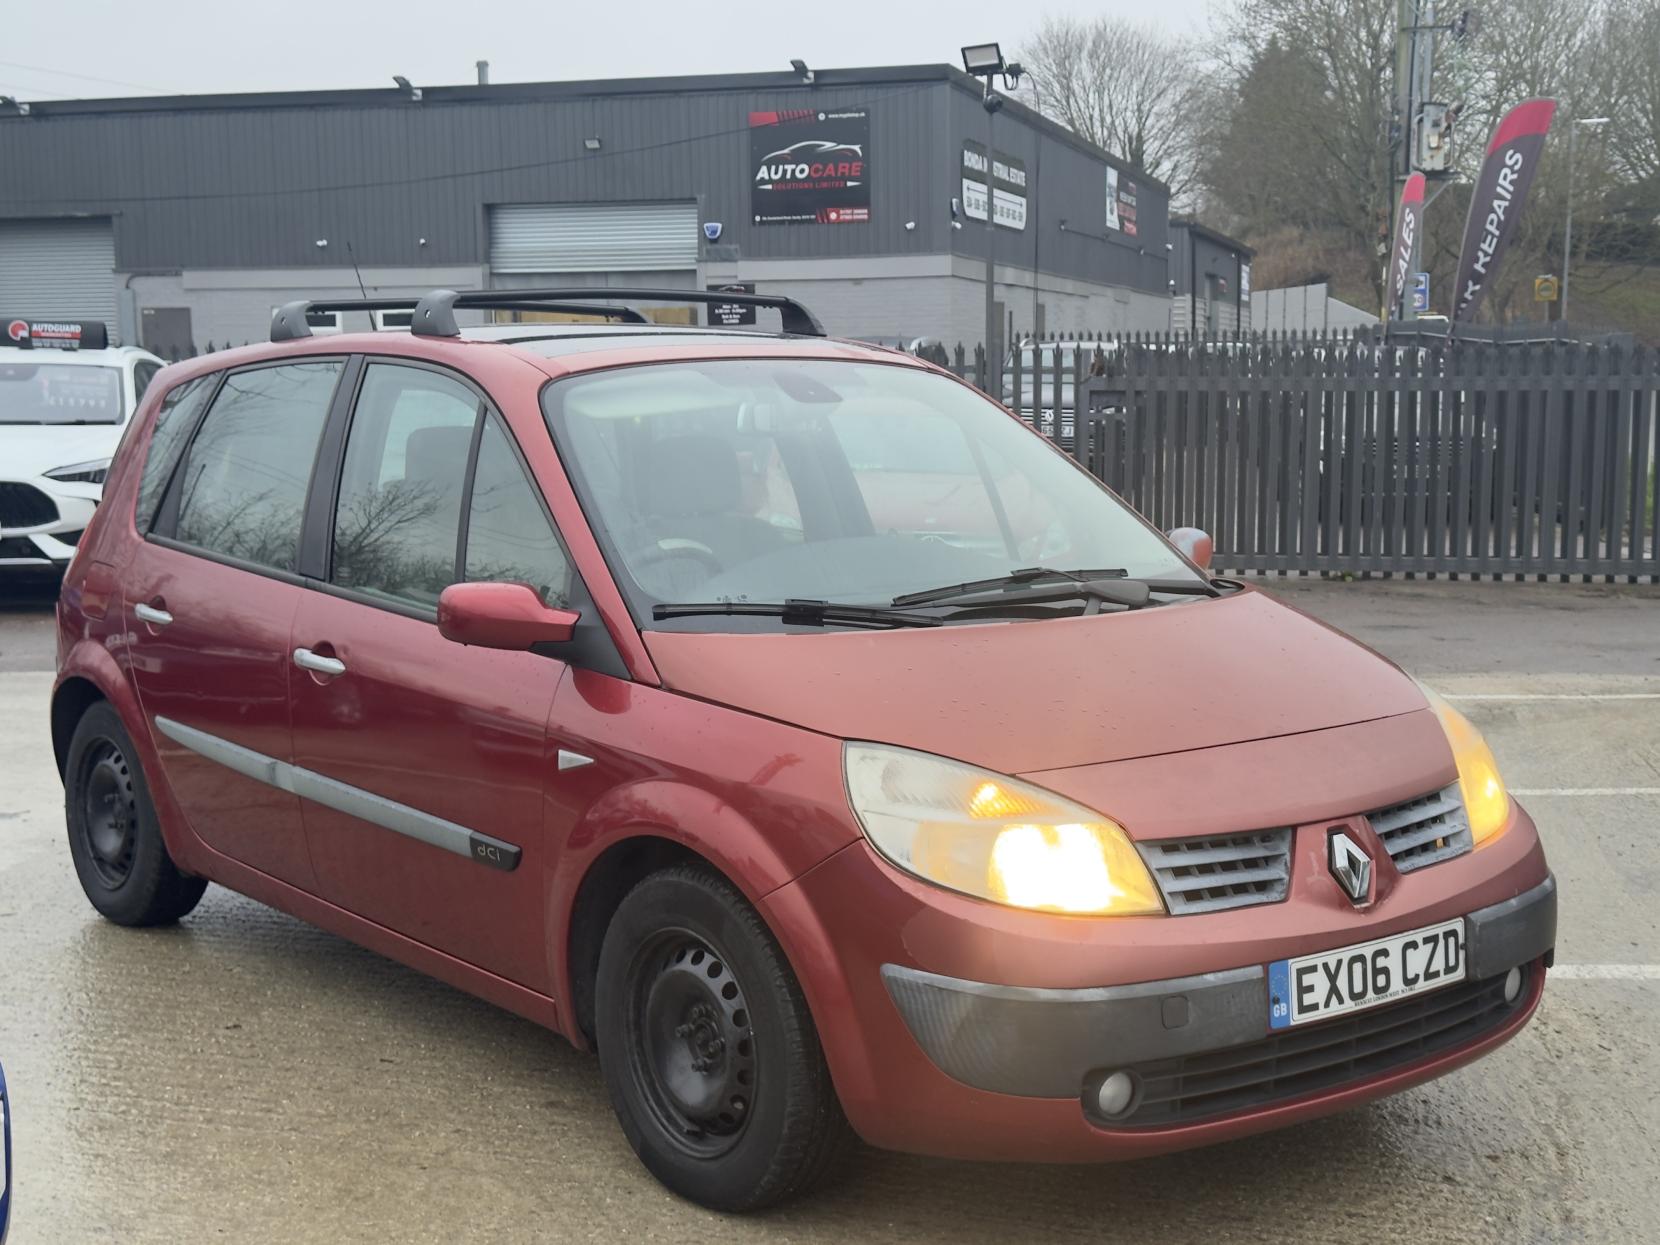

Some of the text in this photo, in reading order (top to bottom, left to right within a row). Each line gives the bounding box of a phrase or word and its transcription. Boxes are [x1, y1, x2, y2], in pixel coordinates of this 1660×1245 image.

[756, 162, 863, 180] AUTOCARE
[1397, 207, 1416, 295] SALES
[32, 323, 82, 333] AUTOGUARD
[1296, 928, 1460, 1015] EX06 CZD
[1273, 1002, 1288, 1018] GB
